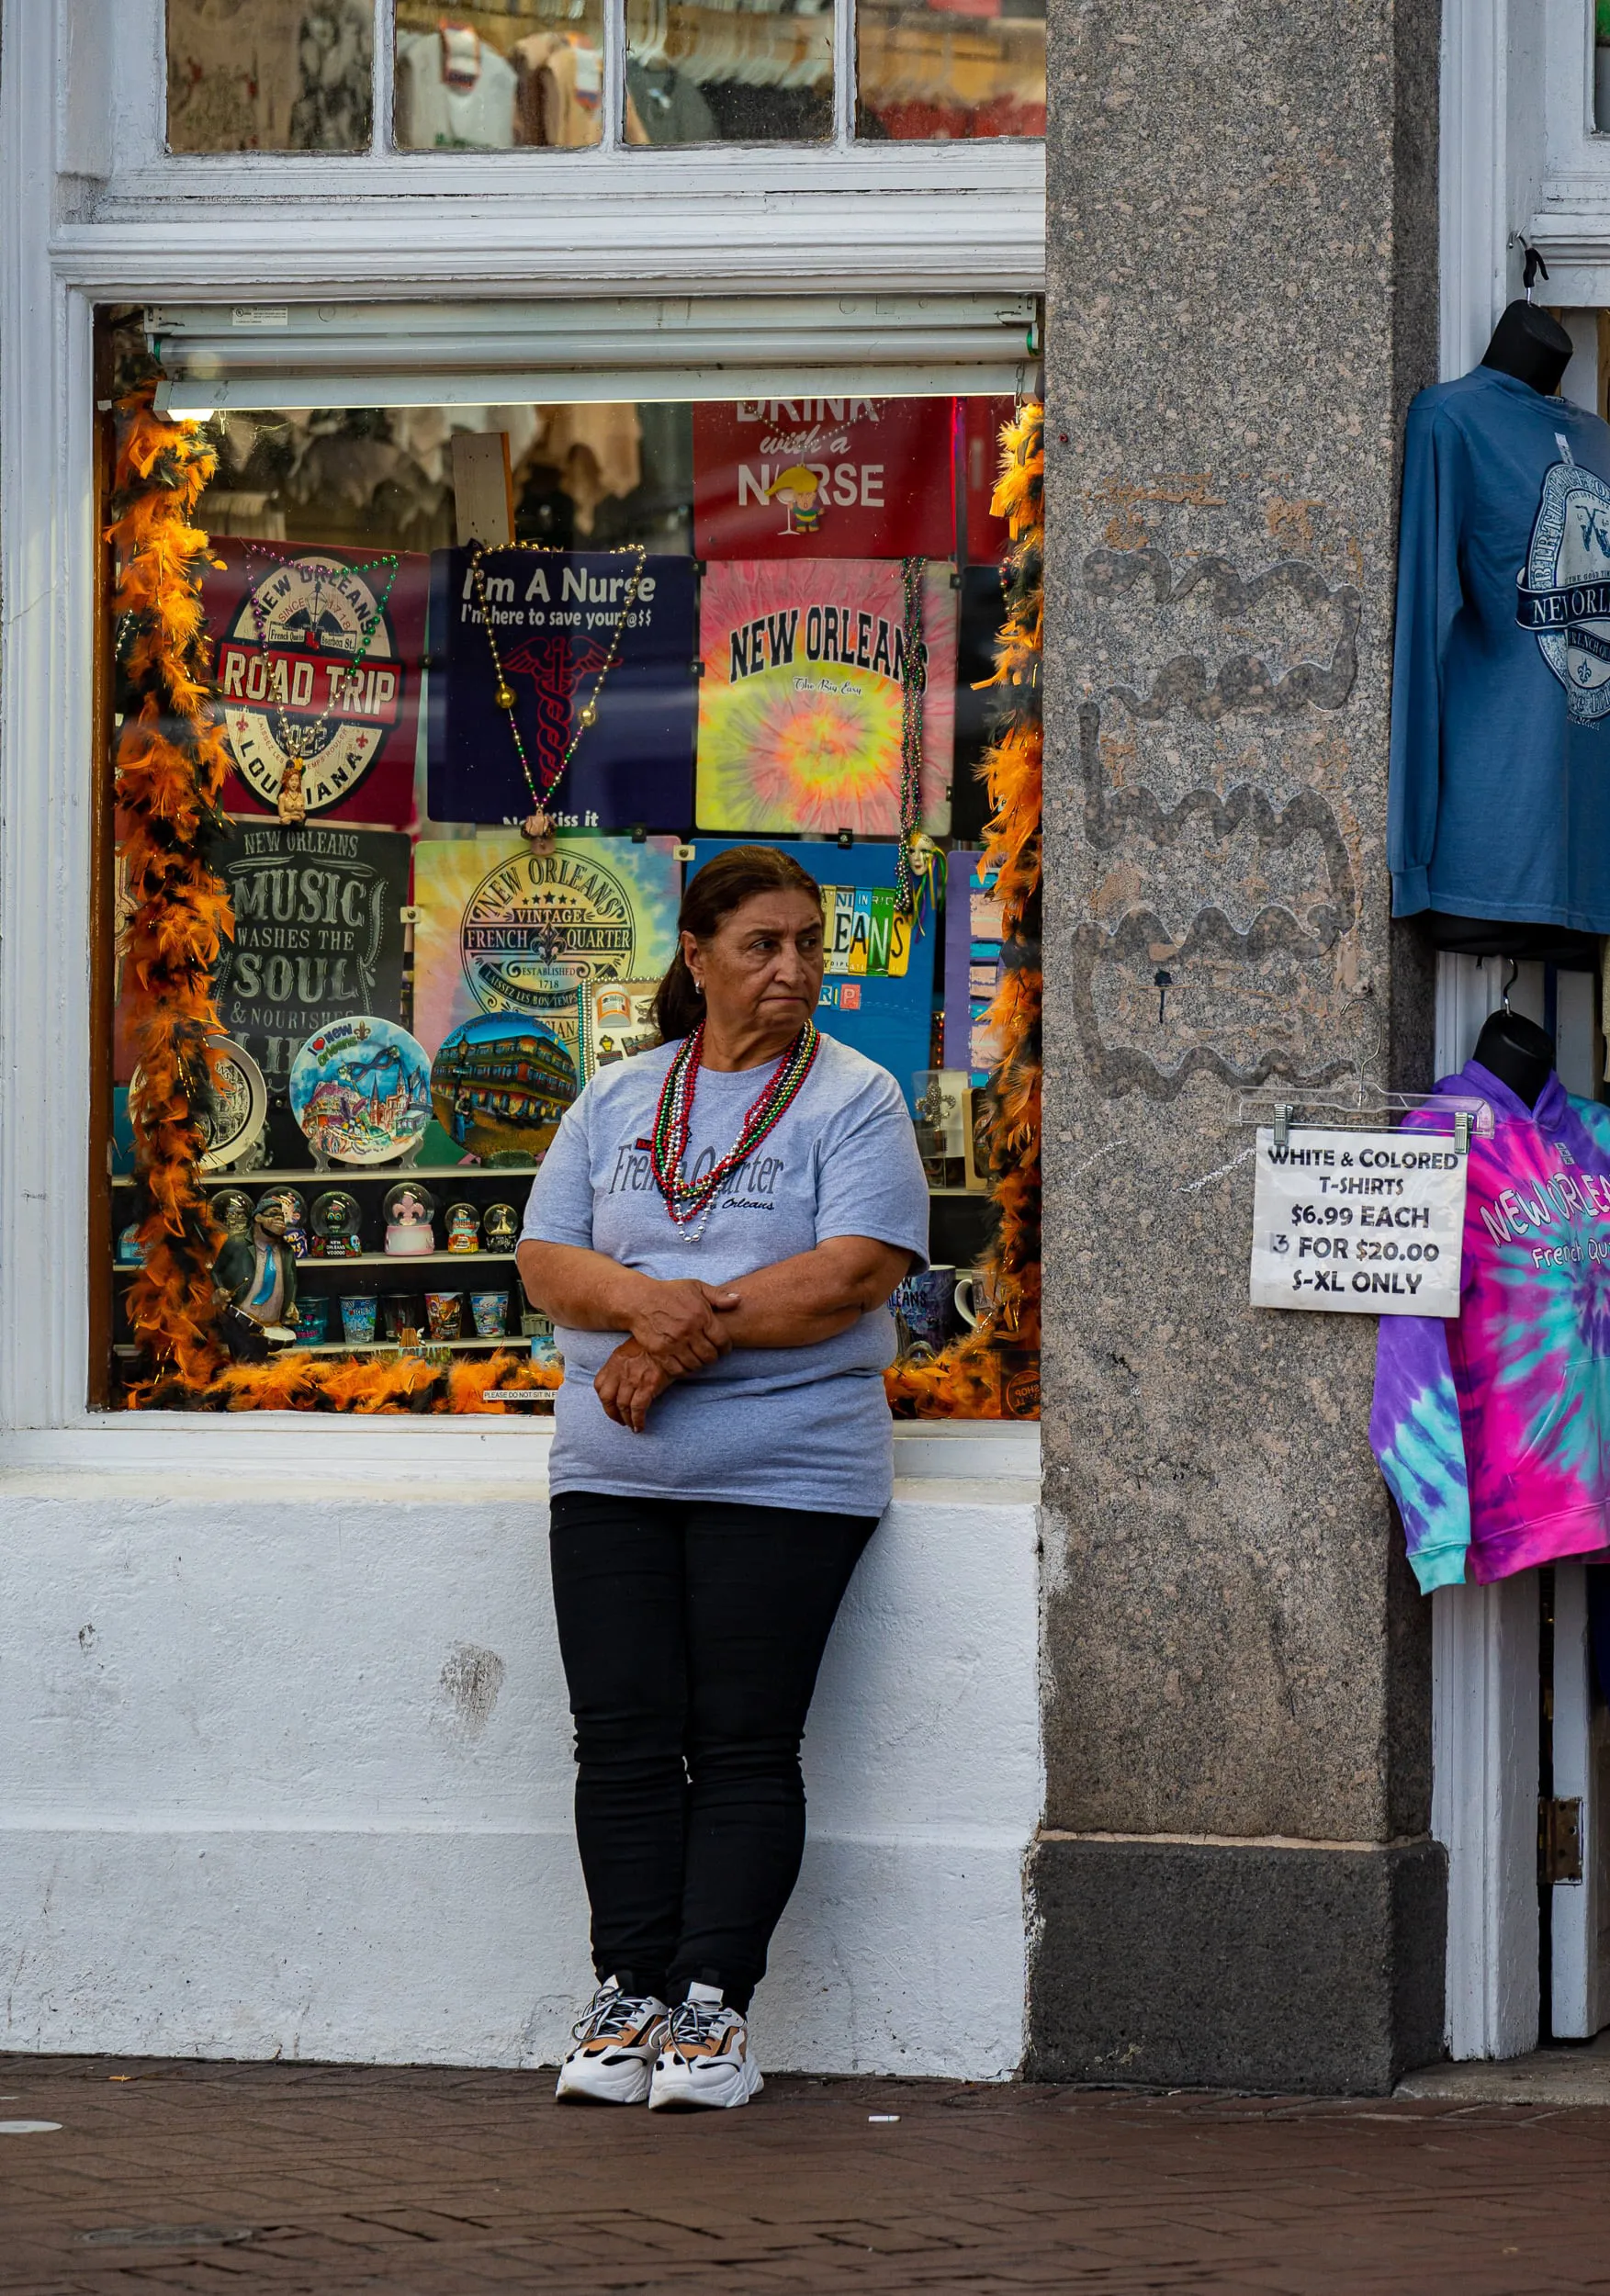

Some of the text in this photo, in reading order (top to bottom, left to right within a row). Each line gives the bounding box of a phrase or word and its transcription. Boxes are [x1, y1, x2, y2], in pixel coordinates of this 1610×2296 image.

[760, 424, 851, 455] with a
[738, 463, 884, 508] NRSE
[257, 564, 376, 635] NEW ORLEANS
[462, 568, 515, 602] I'm
[524, 568, 551, 602] A
[278, 598, 351, 630] SINCE 1718
[461, 603, 485, 624] I'm
[491, 604, 524, 625] here
[529, 608, 545, 625] to
[549, 611, 581, 625] save
[585, 611, 621, 630] your
[1533, 595, 1568, 625] NE
[270, 628, 288, 641] French
[729, 606, 801, 684] NEW
[223, 651, 395, 715] ROAD TRIP
[794, 676, 862, 696] The Big Easy
[257, 717, 285, 764] LAISSEZ LES
[241, 739, 363, 805] LOUIANA
[307, 756, 325, 770] EMPS
[584, 810, 600, 827] it
[243, 830, 359, 860] NEW ORLEANS
[231, 868, 367, 928] MUSIC
[477, 857, 623, 917] NEW ORLEANS
[515, 908, 583, 924] VINTAGE
[237, 927, 355, 951] WASHES THE
[467, 929, 630, 951] FRENCH QUARTER
[232, 952, 359, 1003] SOUL
[522, 966, 576, 977] ESTABLISHED
[538, 979, 559, 990] 1718
[484, 969, 578, 1007] LAISSEZ LES BON TEMPS
[231, 1000, 246, 1024] &
[1267, 1146, 1459, 1170] WHITE & COLORED
[1319, 1176, 1404, 1196] T-SHIRTS
[722, 1197, 775, 1211] Orleans
[1291, 1204, 1430, 1229] $6.99 EACH
[1480, 1180, 1552, 1248] NEW
[1272, 1233, 1440, 1262] 3 FOR $20.00
[1532, 1240, 1585, 1269] French
[1291, 1269, 1423, 1295] S-XL ONLY
